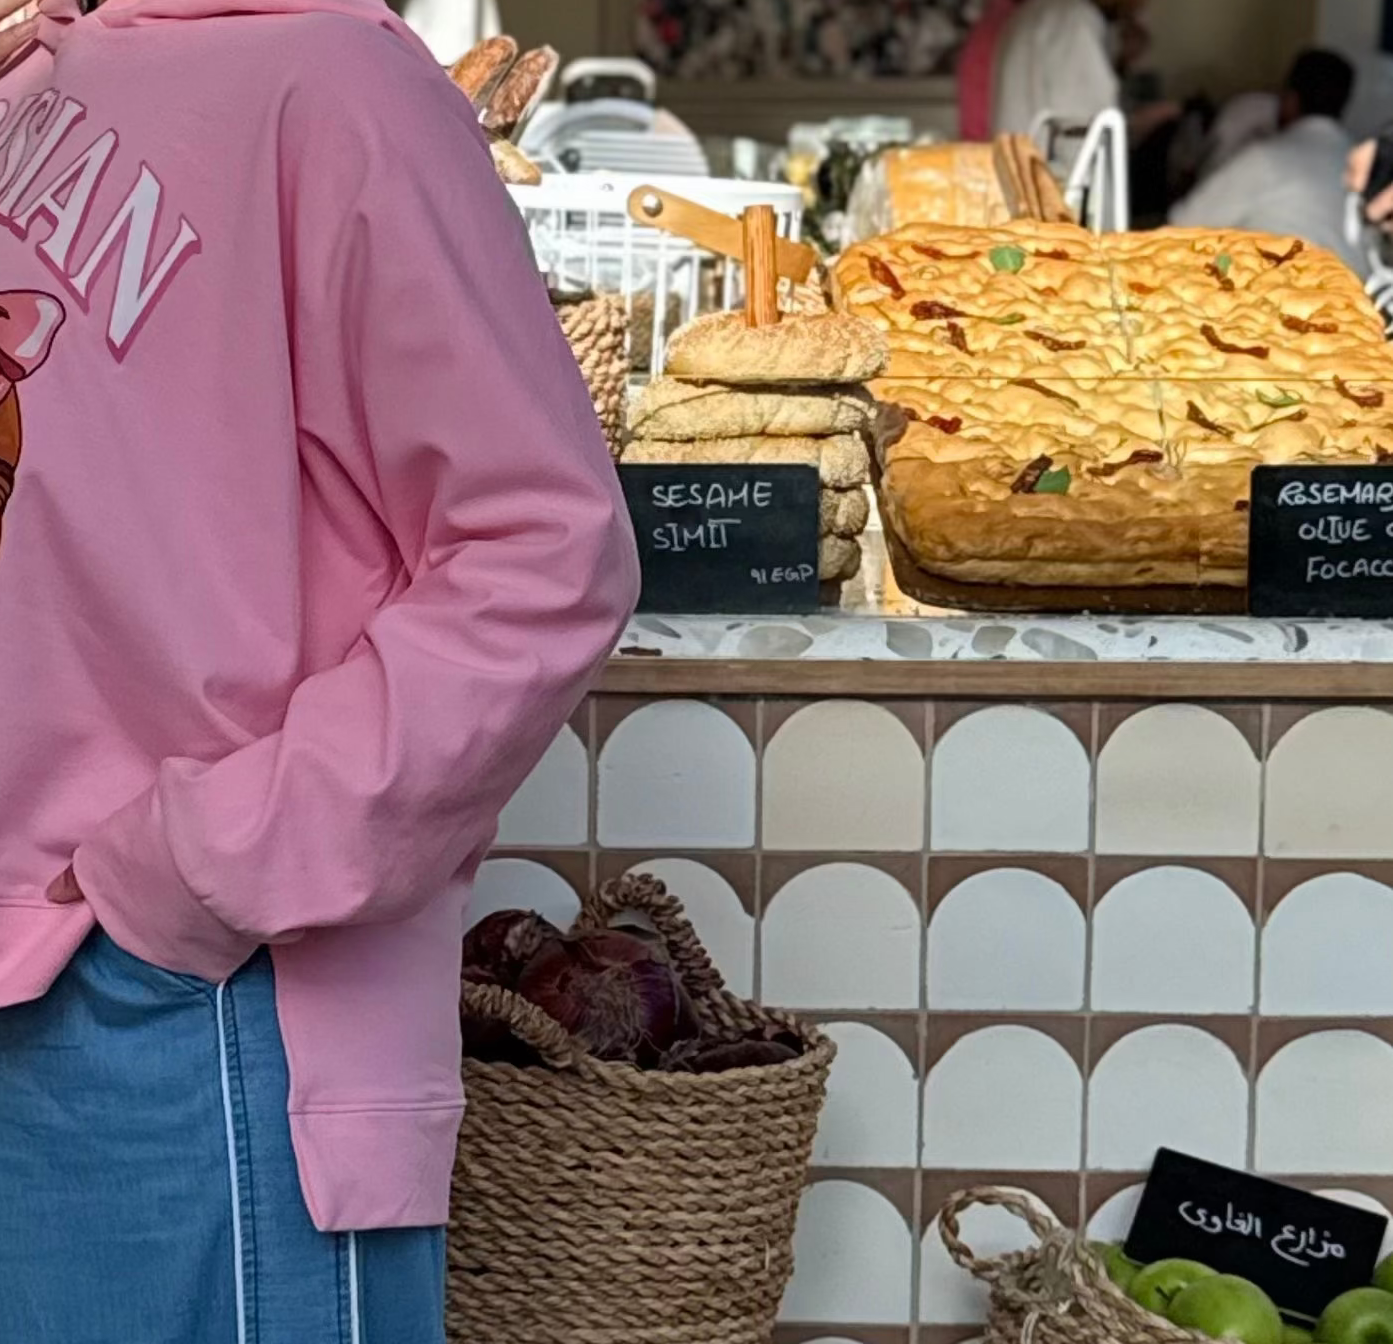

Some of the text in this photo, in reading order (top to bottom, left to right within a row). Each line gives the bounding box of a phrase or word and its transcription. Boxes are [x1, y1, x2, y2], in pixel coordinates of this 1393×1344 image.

[652, 481, 772, 508] SESAME
[652, 518, 741, 551] SIMIT
[1298, 516, 1373, 544] OLIVE
[1271, 1223, 1347, 1267] مزارع
